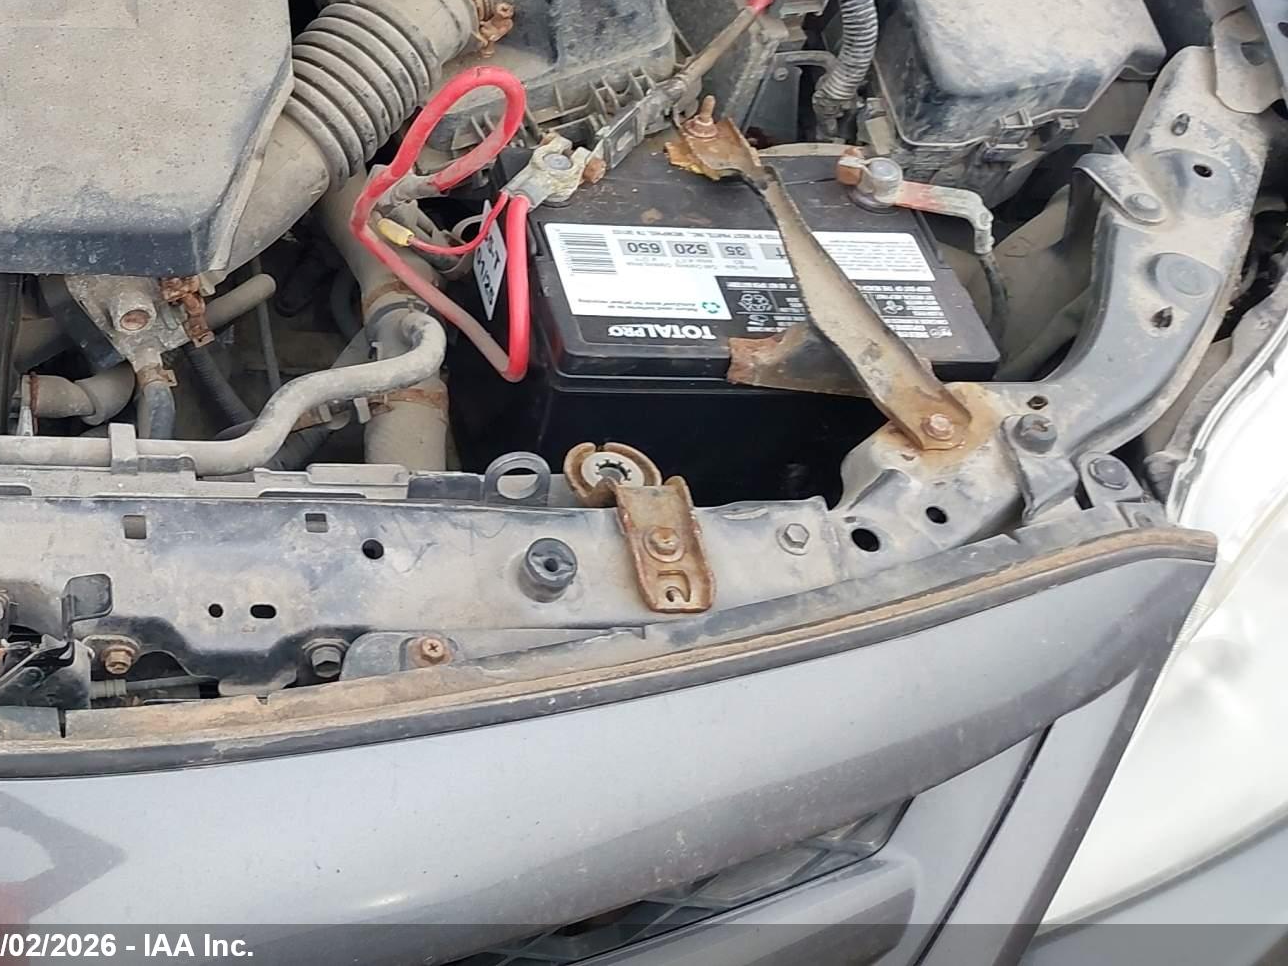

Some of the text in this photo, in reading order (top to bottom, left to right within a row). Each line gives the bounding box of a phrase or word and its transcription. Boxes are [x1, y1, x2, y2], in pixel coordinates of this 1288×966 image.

[627, 241, 661, 254] 650
[674, 243, 709, 255] 520
[724, 245, 748, 257] 35
[608, 323, 718, 340] TOTALPRO
